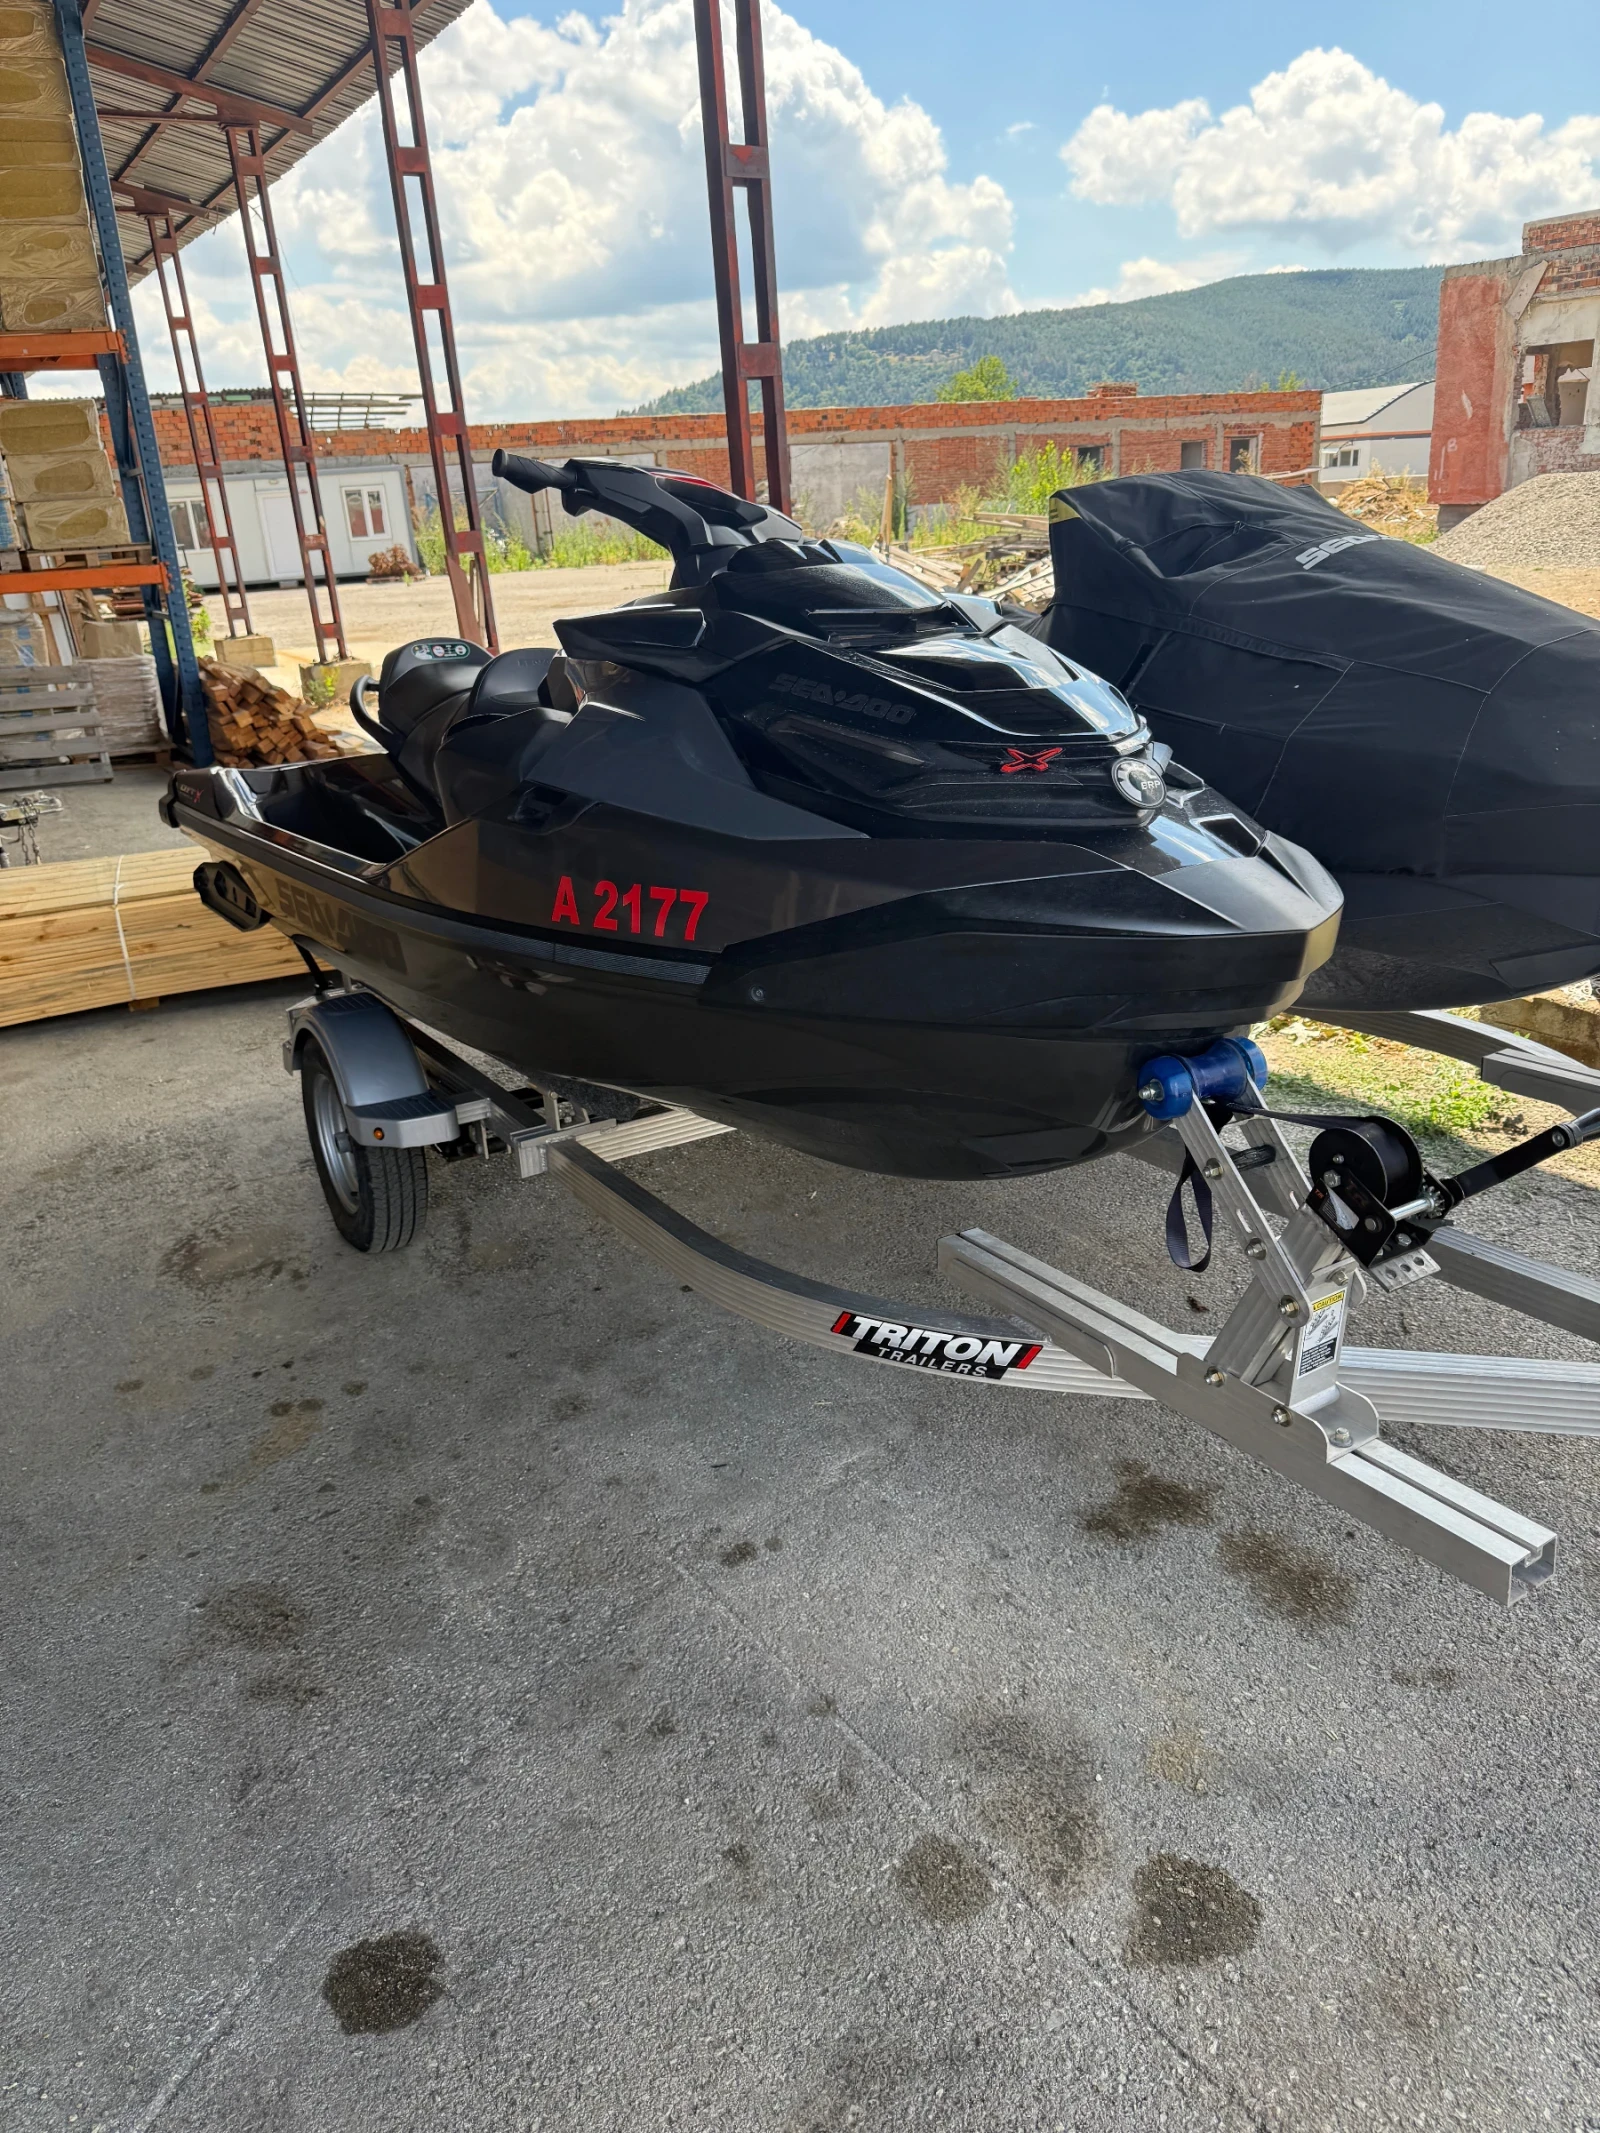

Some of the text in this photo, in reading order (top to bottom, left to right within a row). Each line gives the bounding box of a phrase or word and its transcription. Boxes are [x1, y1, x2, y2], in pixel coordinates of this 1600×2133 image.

[551, 875, 709, 941] A 2177
[1315, 1293, 1343, 1311] CAUTION
[852, 1315, 1022, 1367] TRITON
[878, 1347, 988, 1378] TRAILERS
